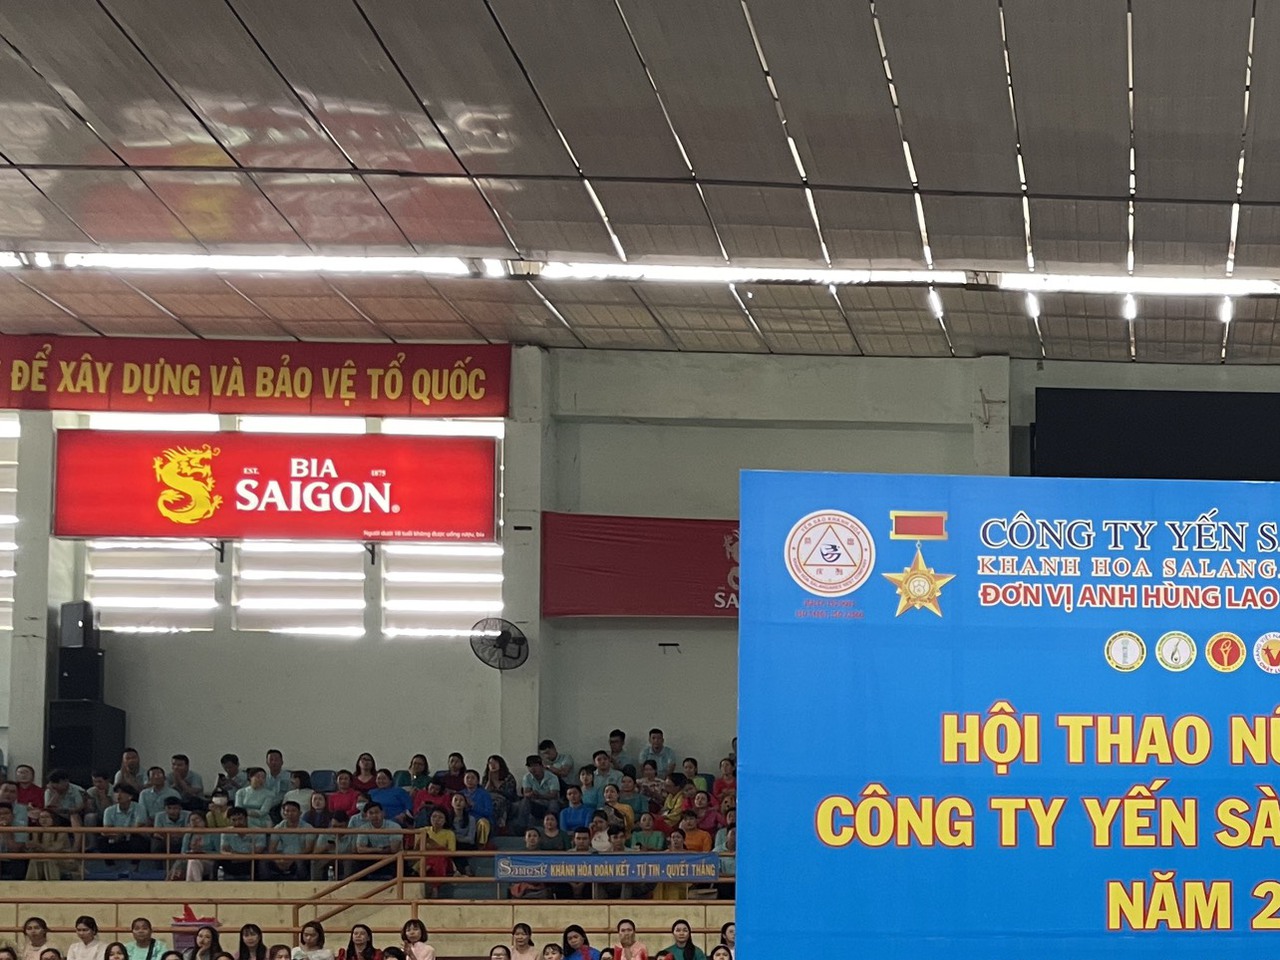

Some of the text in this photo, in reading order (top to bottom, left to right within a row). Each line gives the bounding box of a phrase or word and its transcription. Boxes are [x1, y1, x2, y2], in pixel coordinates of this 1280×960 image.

[11, 344, 486, 406] ĐỂ XÂY DỰNG VÀ BẢO VỆ TỔ QUỐC
[290, 457, 339, 478] BIA
[235, 478, 392, 514] SAIGON
[980, 511, 1096, 550] CÔNG
[1103, 520, 1158, 550] TY
[1165, 508, 1249, 551] YẾN
[977, 556, 1081, 576] KHANH
[1091, 557, 1152, 577] HOA
[979, 582, 1040, 607] ĐƠN
[1045, 585, 1073, 612] VỊ
[1077, 584, 1137, 609] ANH
[1143, 582, 1220, 609] HÙNG
[1225, 586, 1279, 610] LAO
[942, 700, 1041, 775] HỘI
[1056, 714, 1212, 765] THAO
[815, 782, 975, 847] CÔNG
[990, 797, 1066, 847] TY
[1081, 778, 1198, 847] YẾN
[1107, 870, 1232, 930] NĂM
